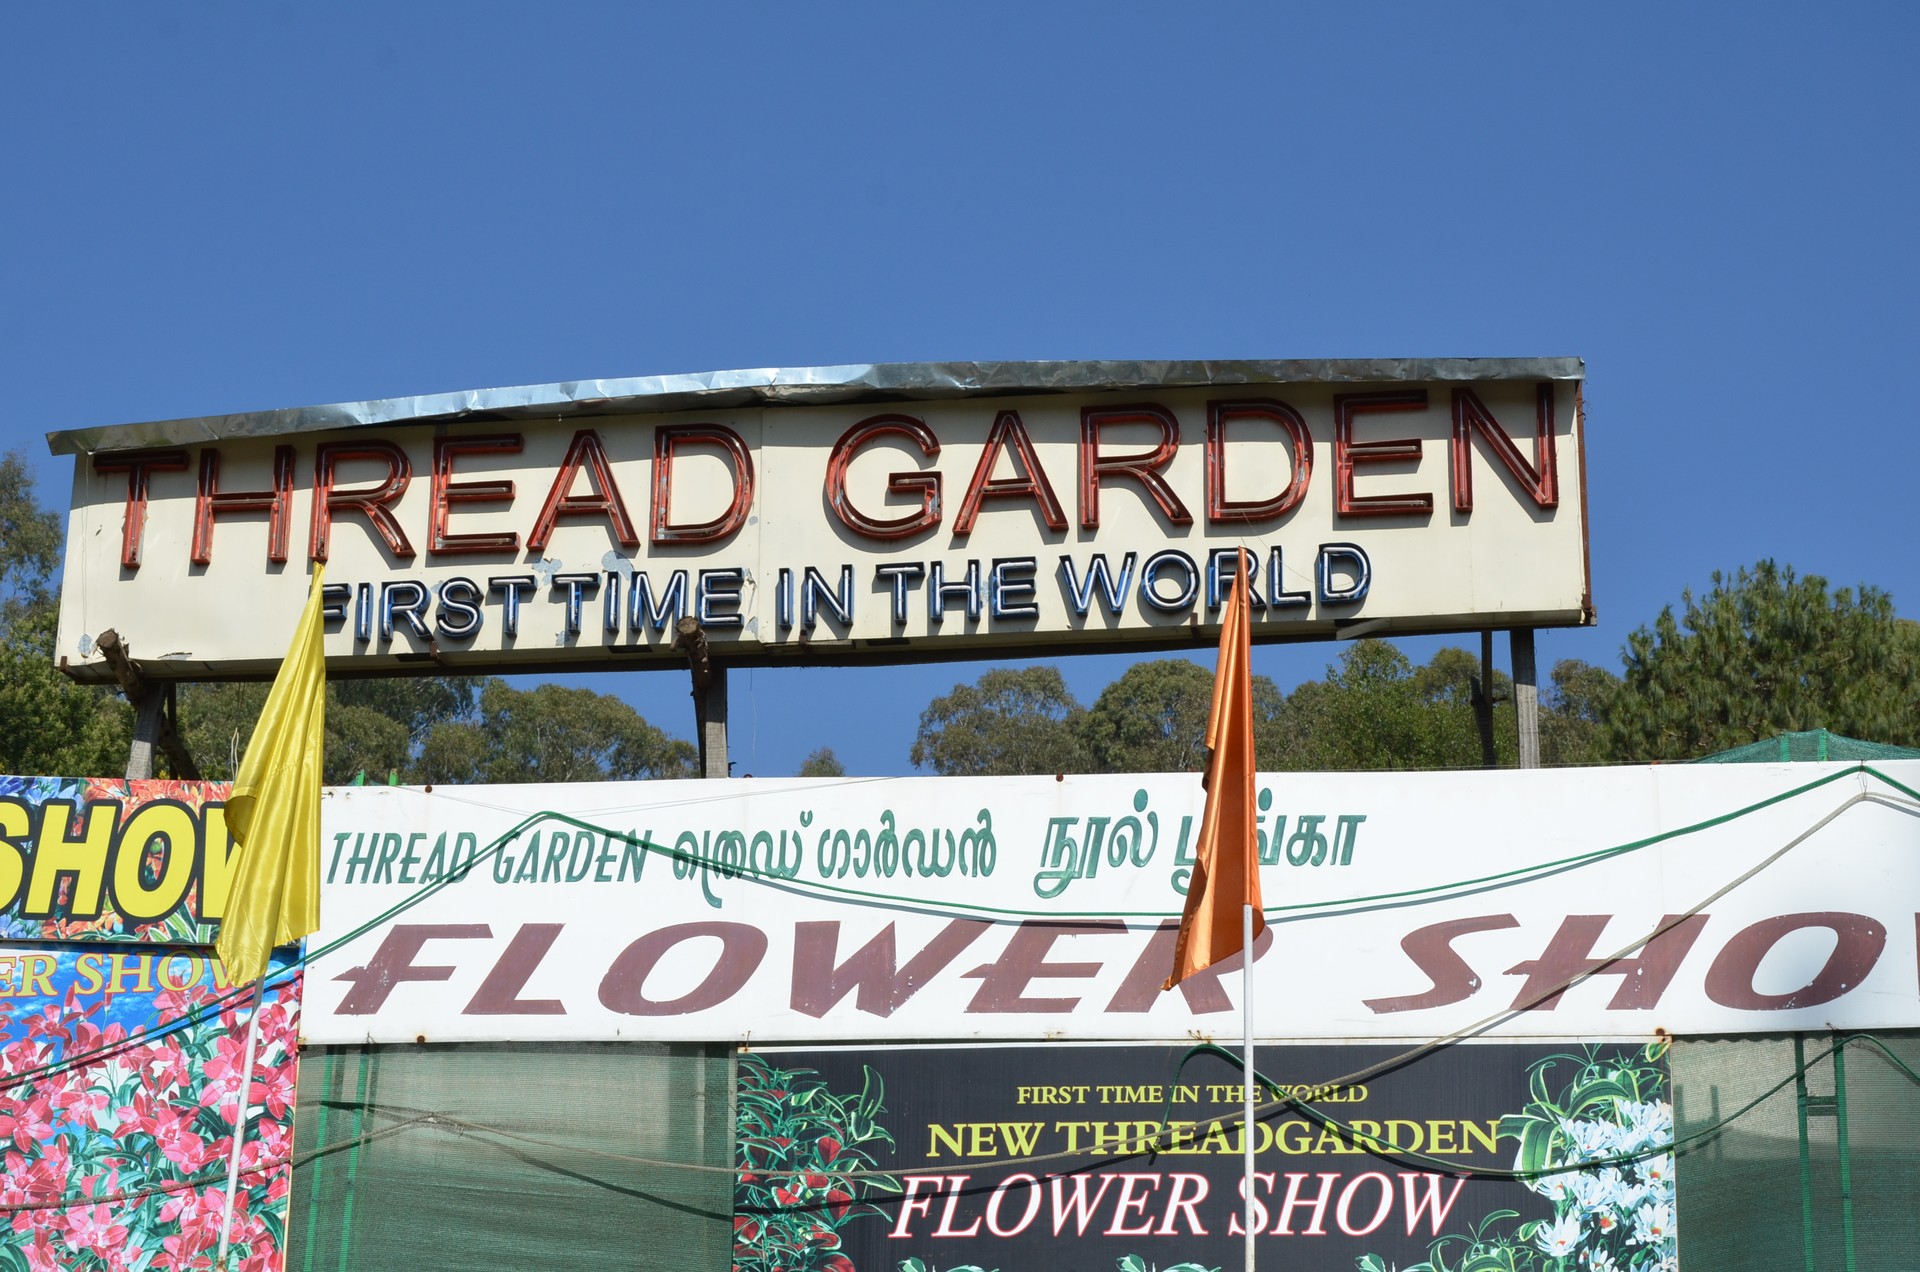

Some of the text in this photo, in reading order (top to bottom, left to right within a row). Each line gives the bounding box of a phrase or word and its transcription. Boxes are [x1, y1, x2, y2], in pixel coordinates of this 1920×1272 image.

[93, 382, 1556, 569] THREAD GARDEN
[310, 541, 1372, 640] FIRST TIME IN THE WORLD
[326, 829, 653, 885] THREAD GARDEN
[1033, 788, 1159, 899] நூல்
[331, 911, 1920, 1019] FLOWER SHO
[1016, 1084, 1369, 1105] FIRST TIME IN THE WORLD
[926, 1119, 1502, 1157] NEW THREADGARDEN
[888, 1171, 1472, 1238] FLOWER SHOW
